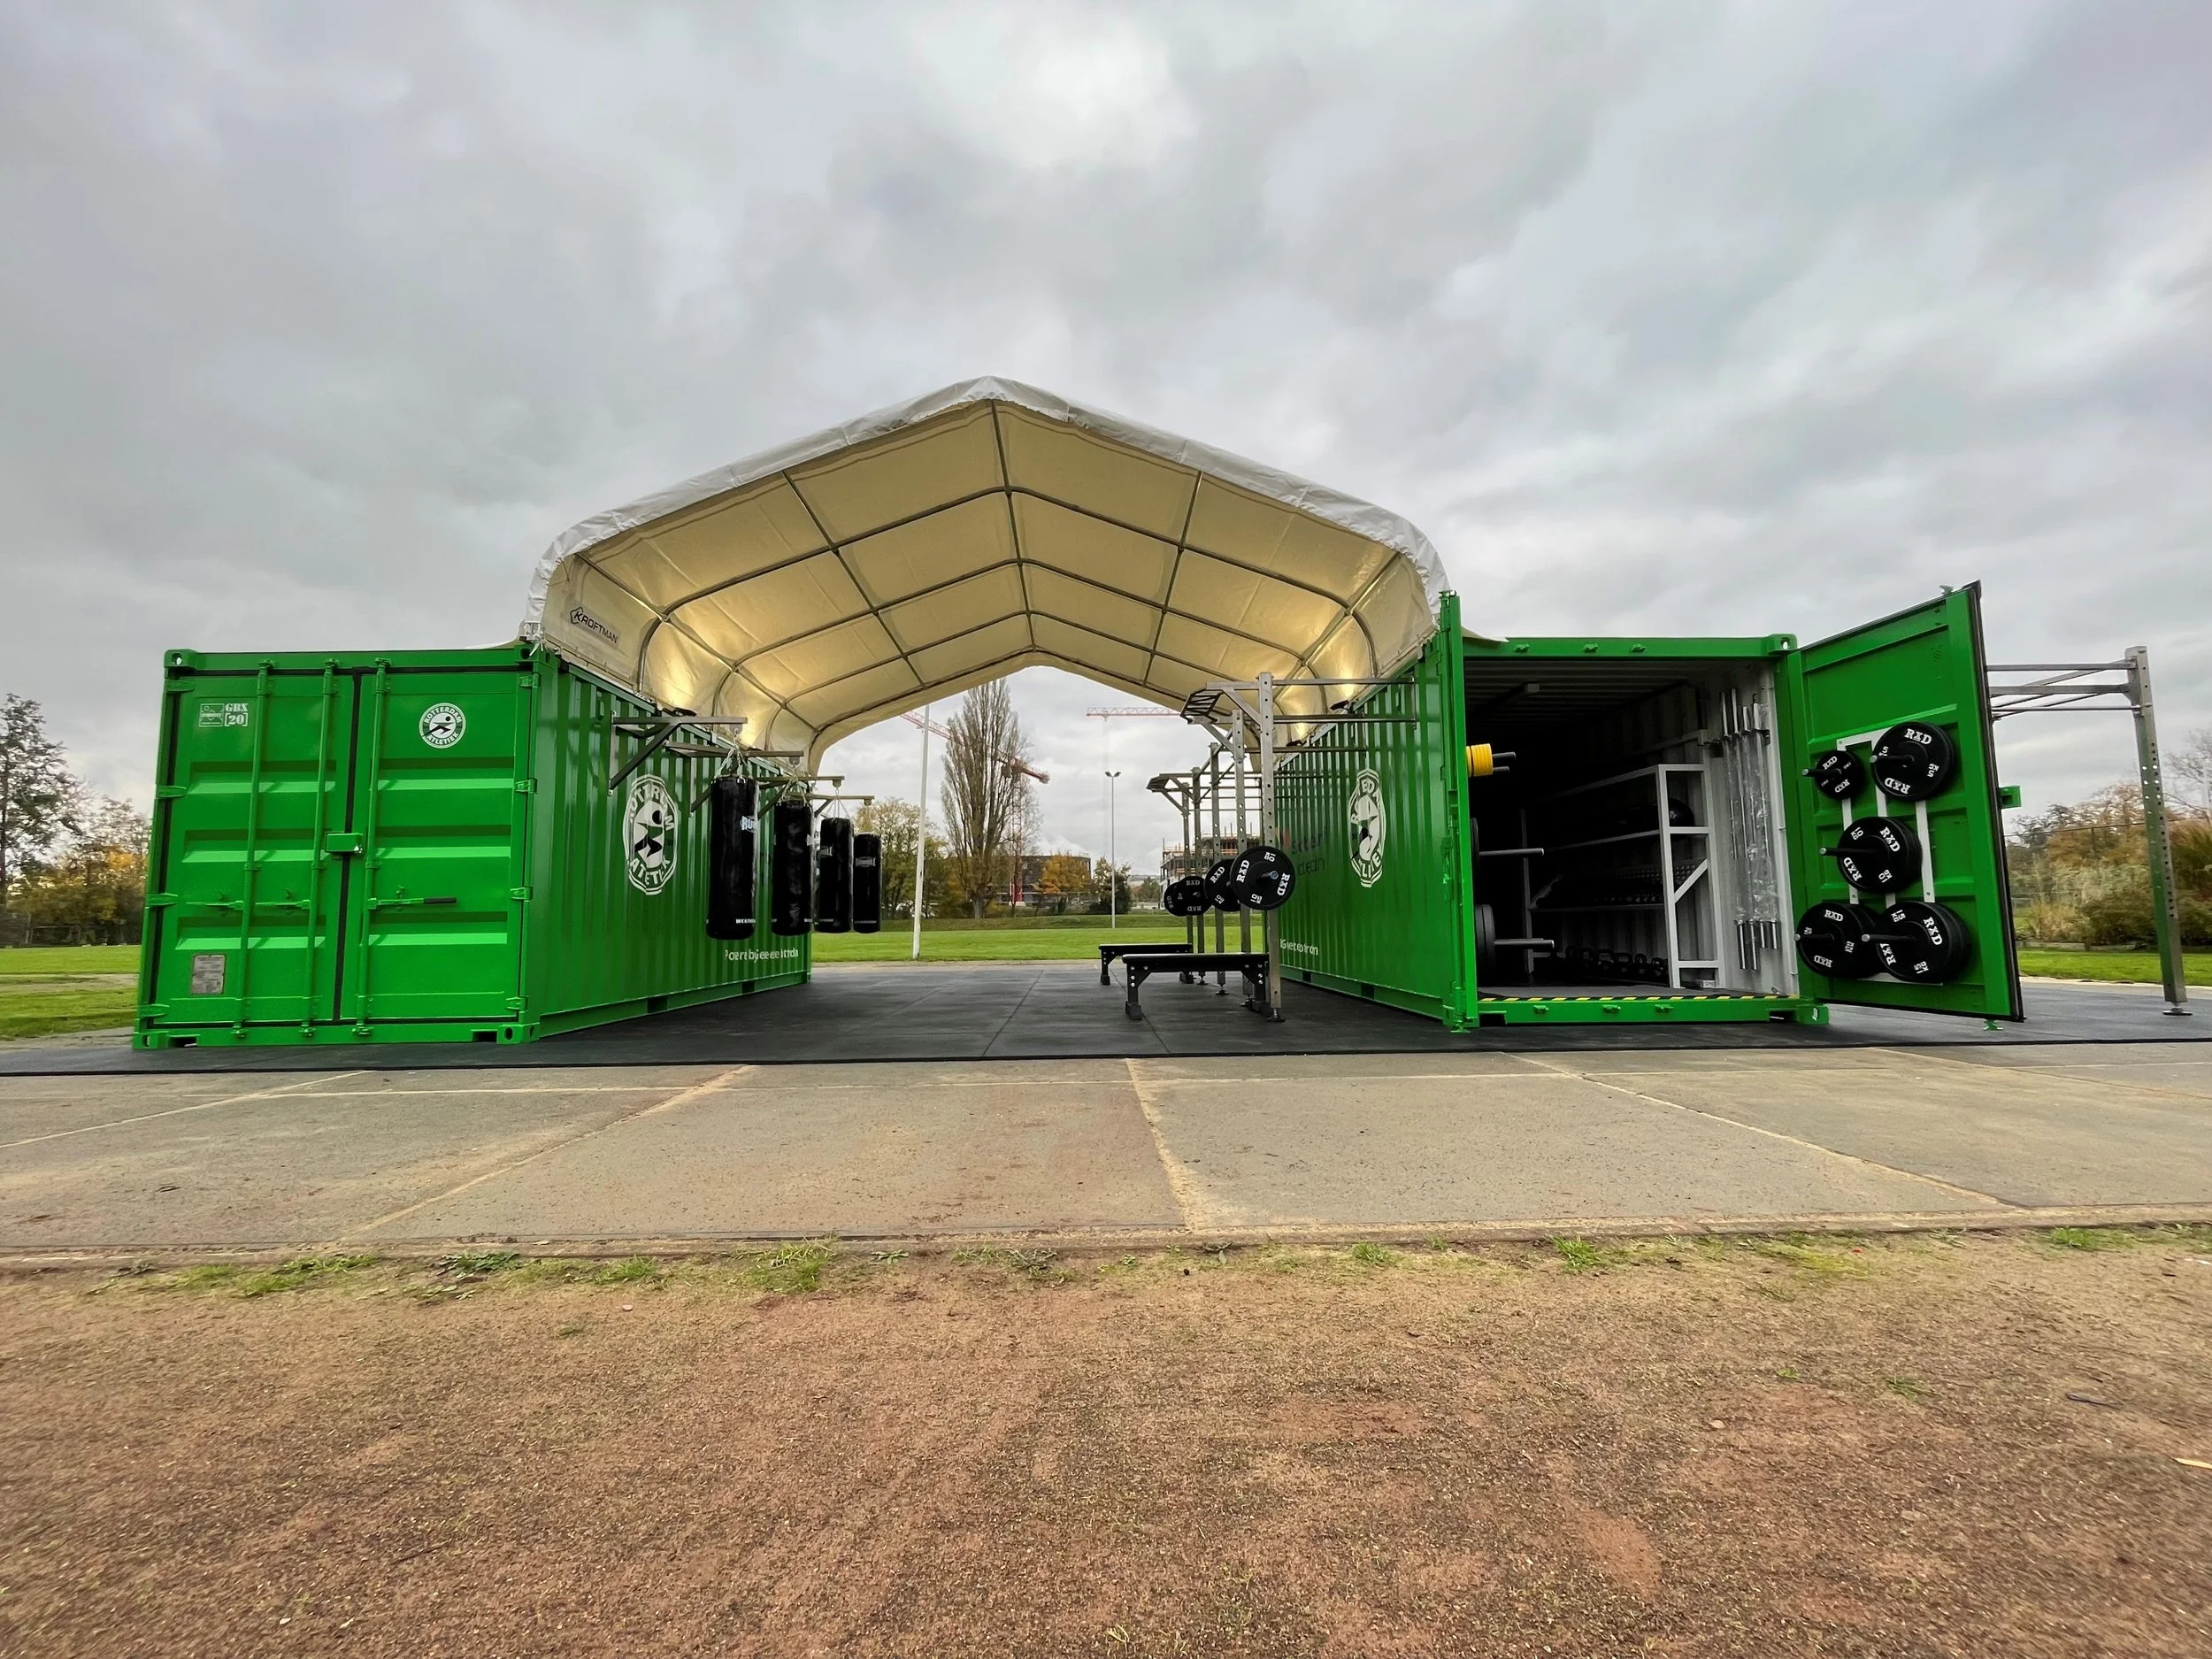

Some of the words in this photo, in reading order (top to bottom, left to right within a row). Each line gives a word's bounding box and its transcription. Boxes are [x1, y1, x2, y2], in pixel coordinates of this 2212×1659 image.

[573, 611, 618, 644] KROFTMAN
[225, 703, 249, 712] GBX
[424, 706, 463, 724] ROTTERDAM
[426, 732, 459, 745] ATLETIEK
[1904, 728, 1932, 745] RXD
[1823, 756, 1838, 770] RXD
[1834, 779, 1850, 793] RXD
[1885, 777, 1911, 795] RXD
[1879, 826, 1901, 852] RXD
[1210, 866, 1225, 884] RXD
[1236, 859, 1250, 883] RXD
[1843, 856, 1863, 882] RXD
[1277, 872, 1291, 896] RXD
[1824, 909, 1844, 922] RXD
[1923, 916, 1943, 946] RXD
[1813, 955, 1833, 968] RXD
